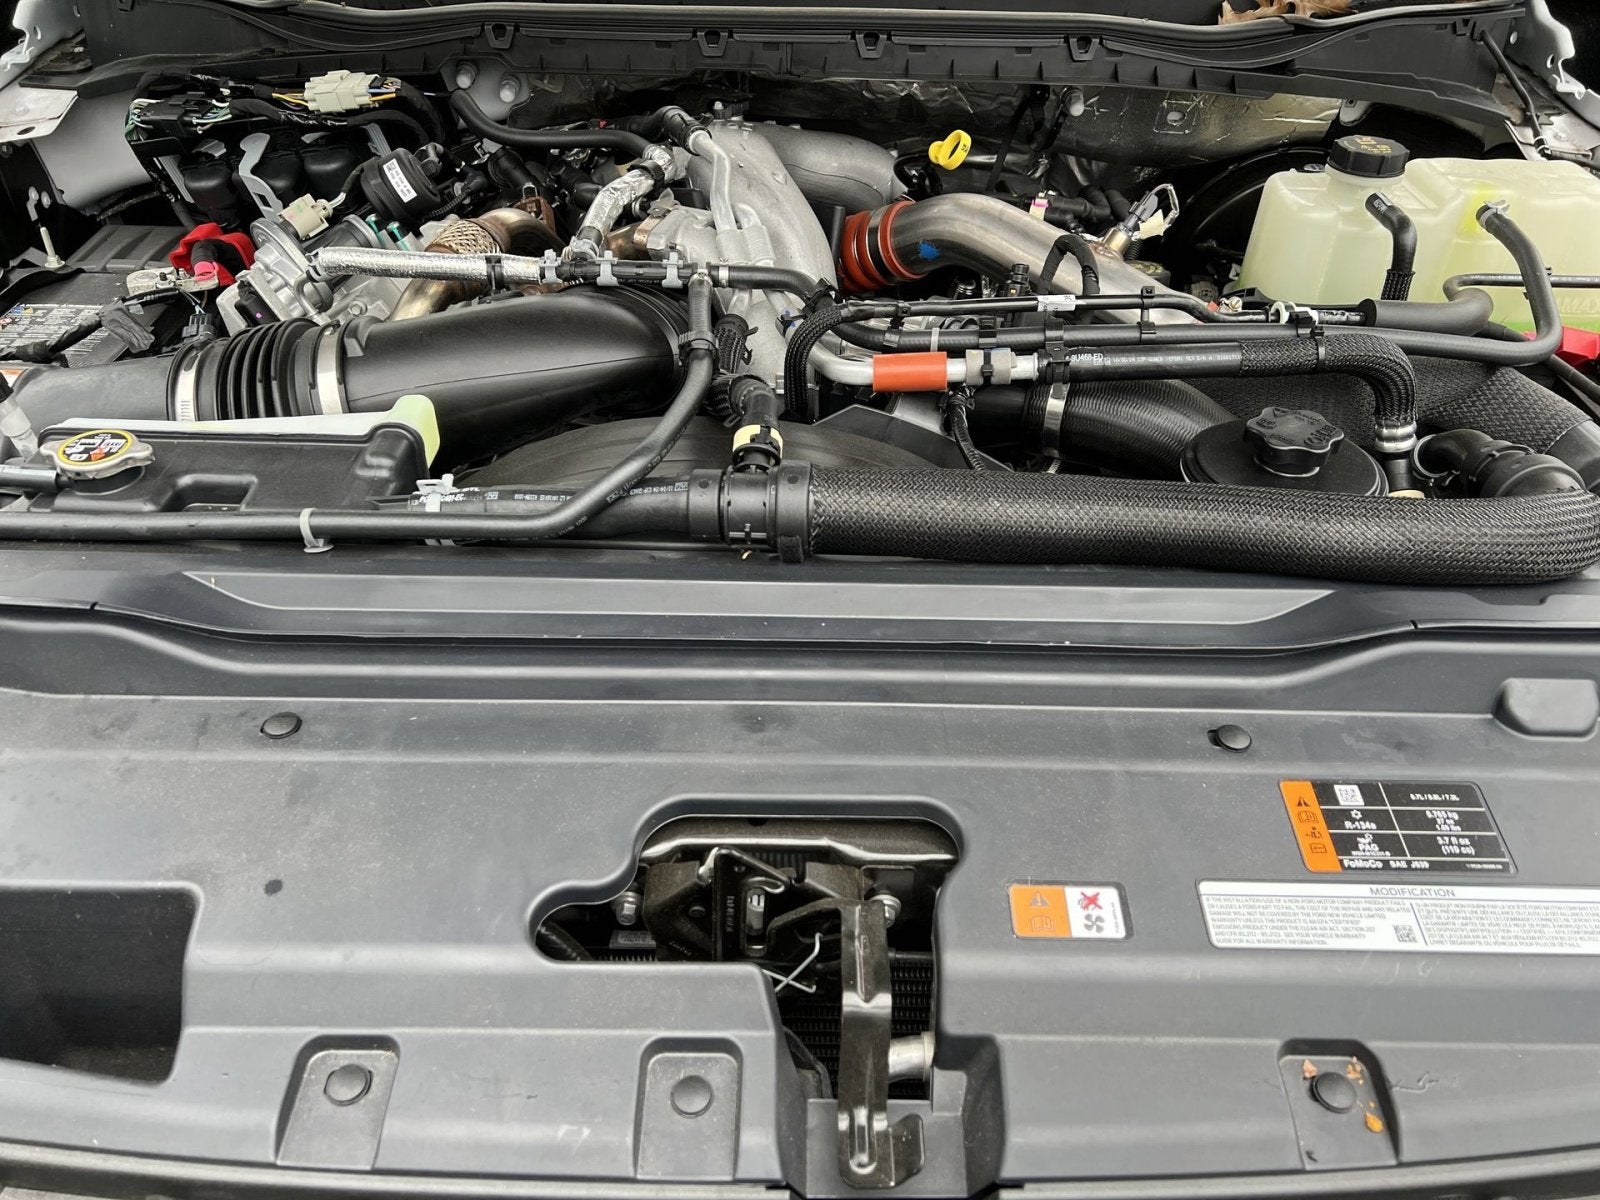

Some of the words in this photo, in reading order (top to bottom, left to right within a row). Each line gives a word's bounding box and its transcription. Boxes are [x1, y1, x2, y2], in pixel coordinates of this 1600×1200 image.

[1344, 820, 1377, 829] R-134a
[1343, 859, 1383, 869] FoMoCo
[1390, 860, 1408, 868] SAE
[1370, 888, 1456, 896] MODIFICATION
